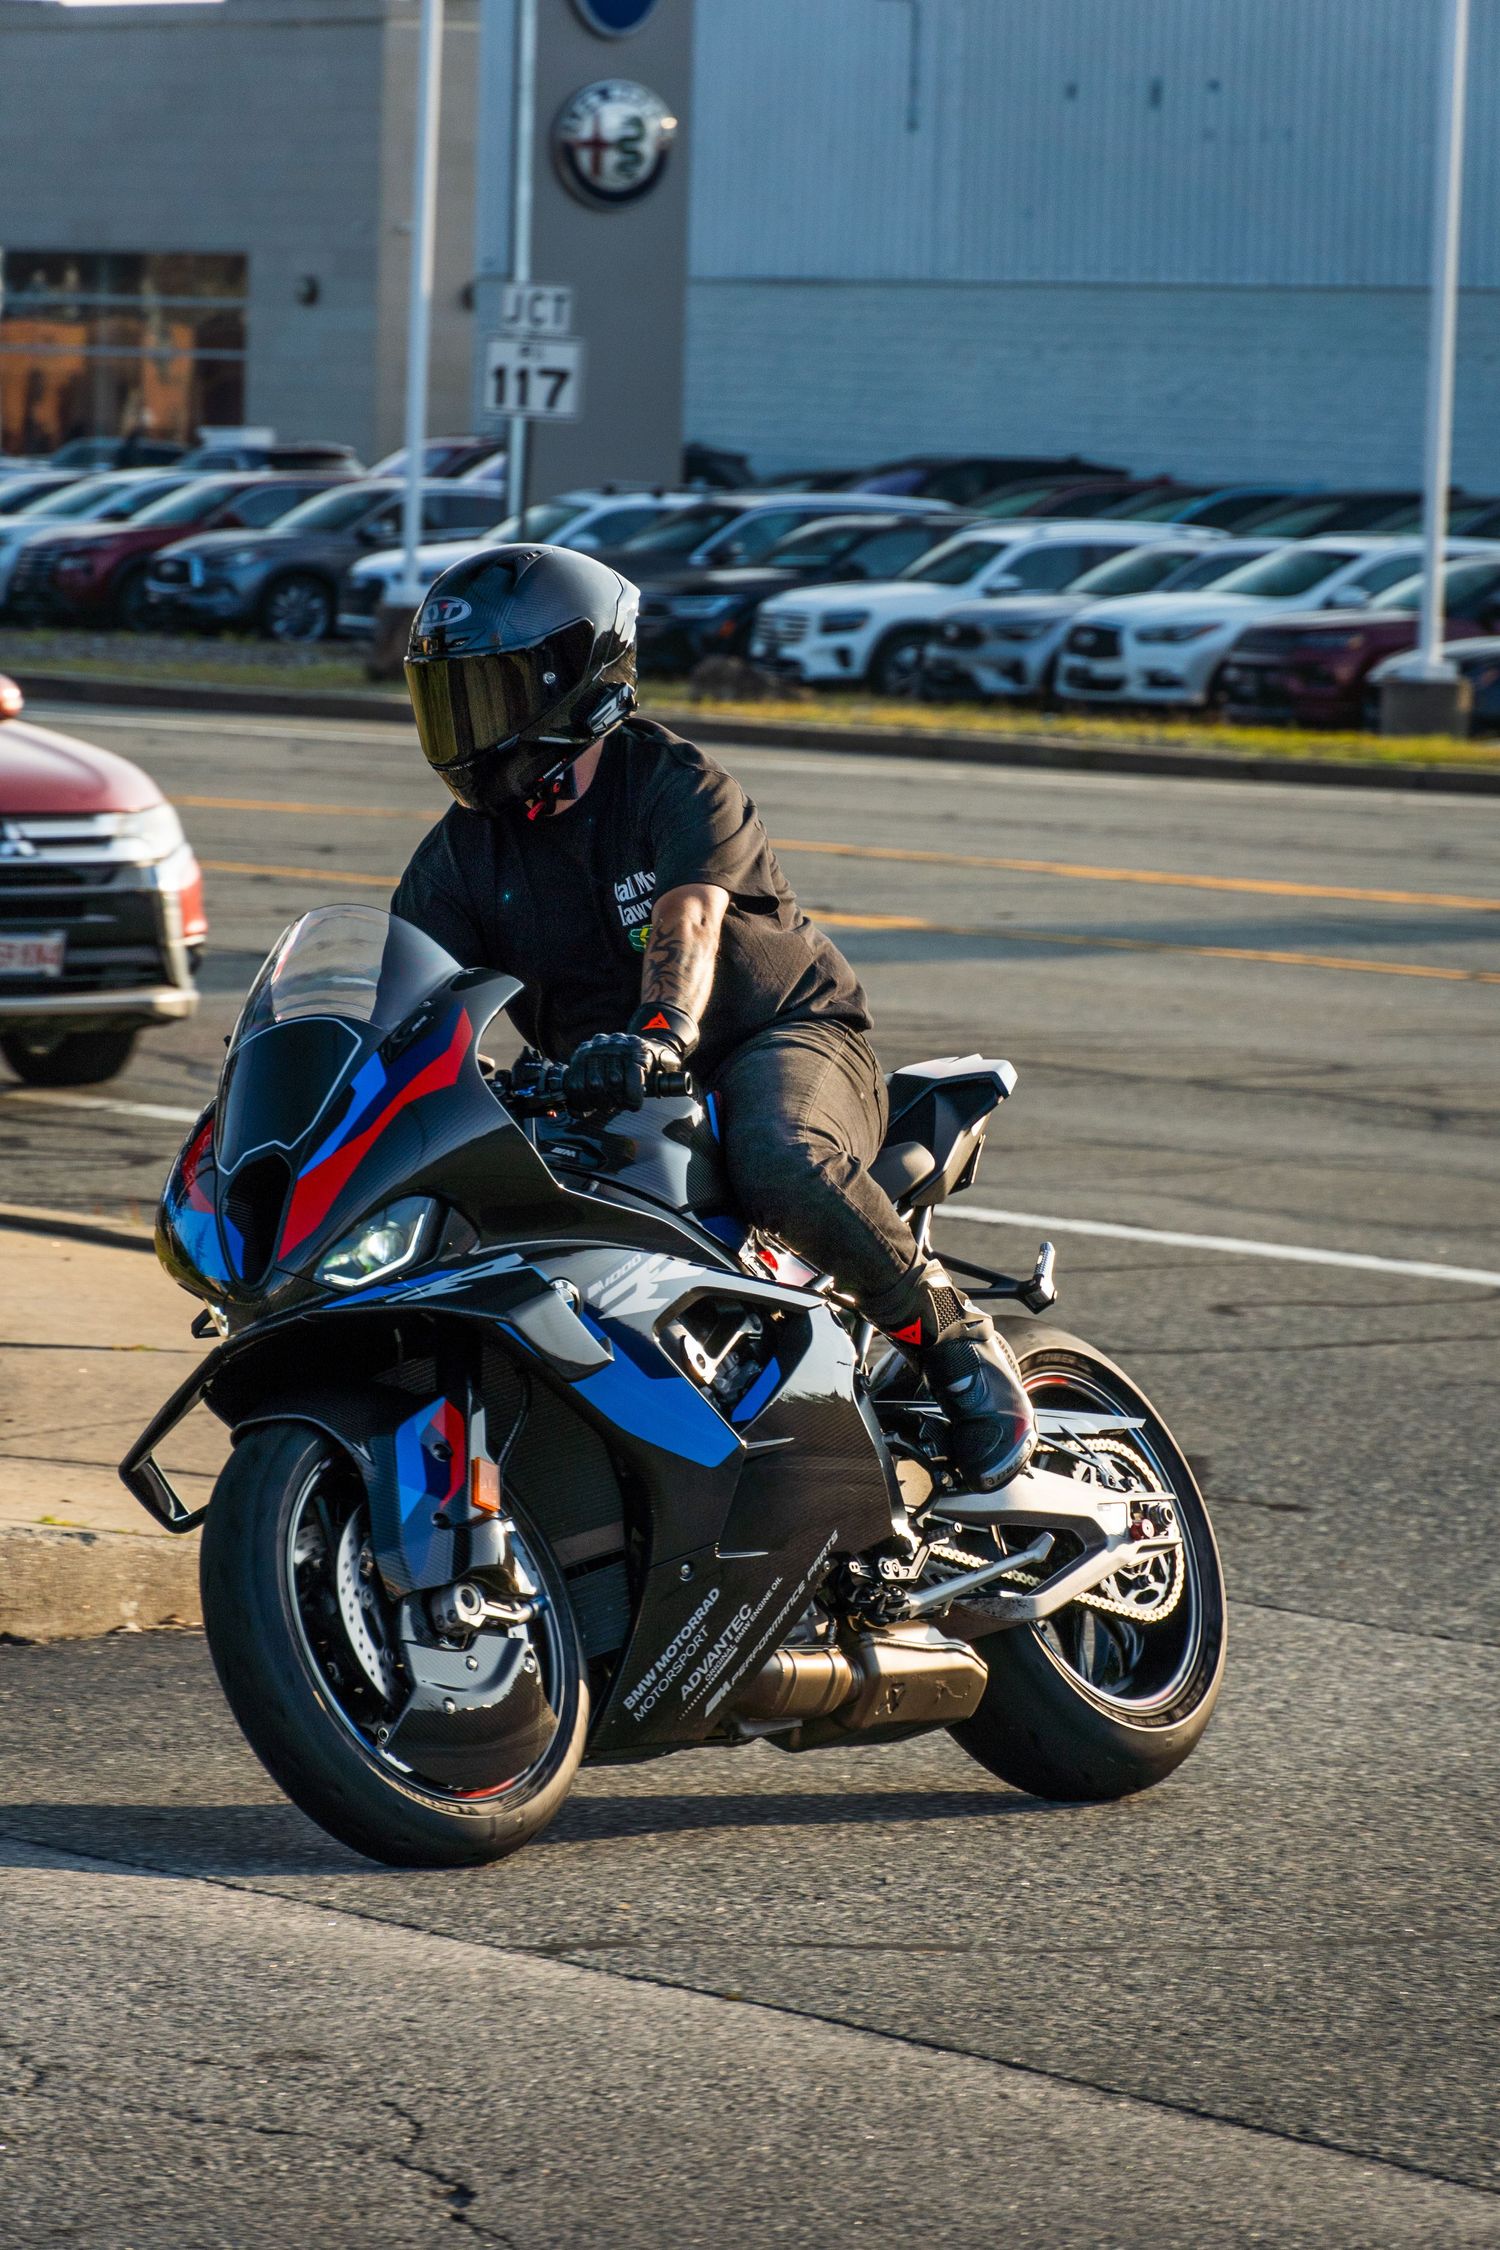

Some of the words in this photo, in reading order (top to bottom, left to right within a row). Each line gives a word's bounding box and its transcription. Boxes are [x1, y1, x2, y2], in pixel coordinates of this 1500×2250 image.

[505, 293, 567, 324] JCT
[492, 365, 570, 409] 117
[623, 1668, 656, 1710] BMW
[655, 1587, 720, 1673] MOTORRAD
[680, 1602, 752, 1701] ADVANTEC
[705, 1644, 736, 1682] ORIGINAL
[734, 1618, 751, 1643] BMW
[749, 1587, 773, 1622] ENGINE
[771, 1576, 783, 1591] OIL
[731, 1580, 806, 1686] PERFORMANCE
[807, 1529, 839, 1580] PARTS
[633, 1624, 710, 1722] MOTORSPORT
